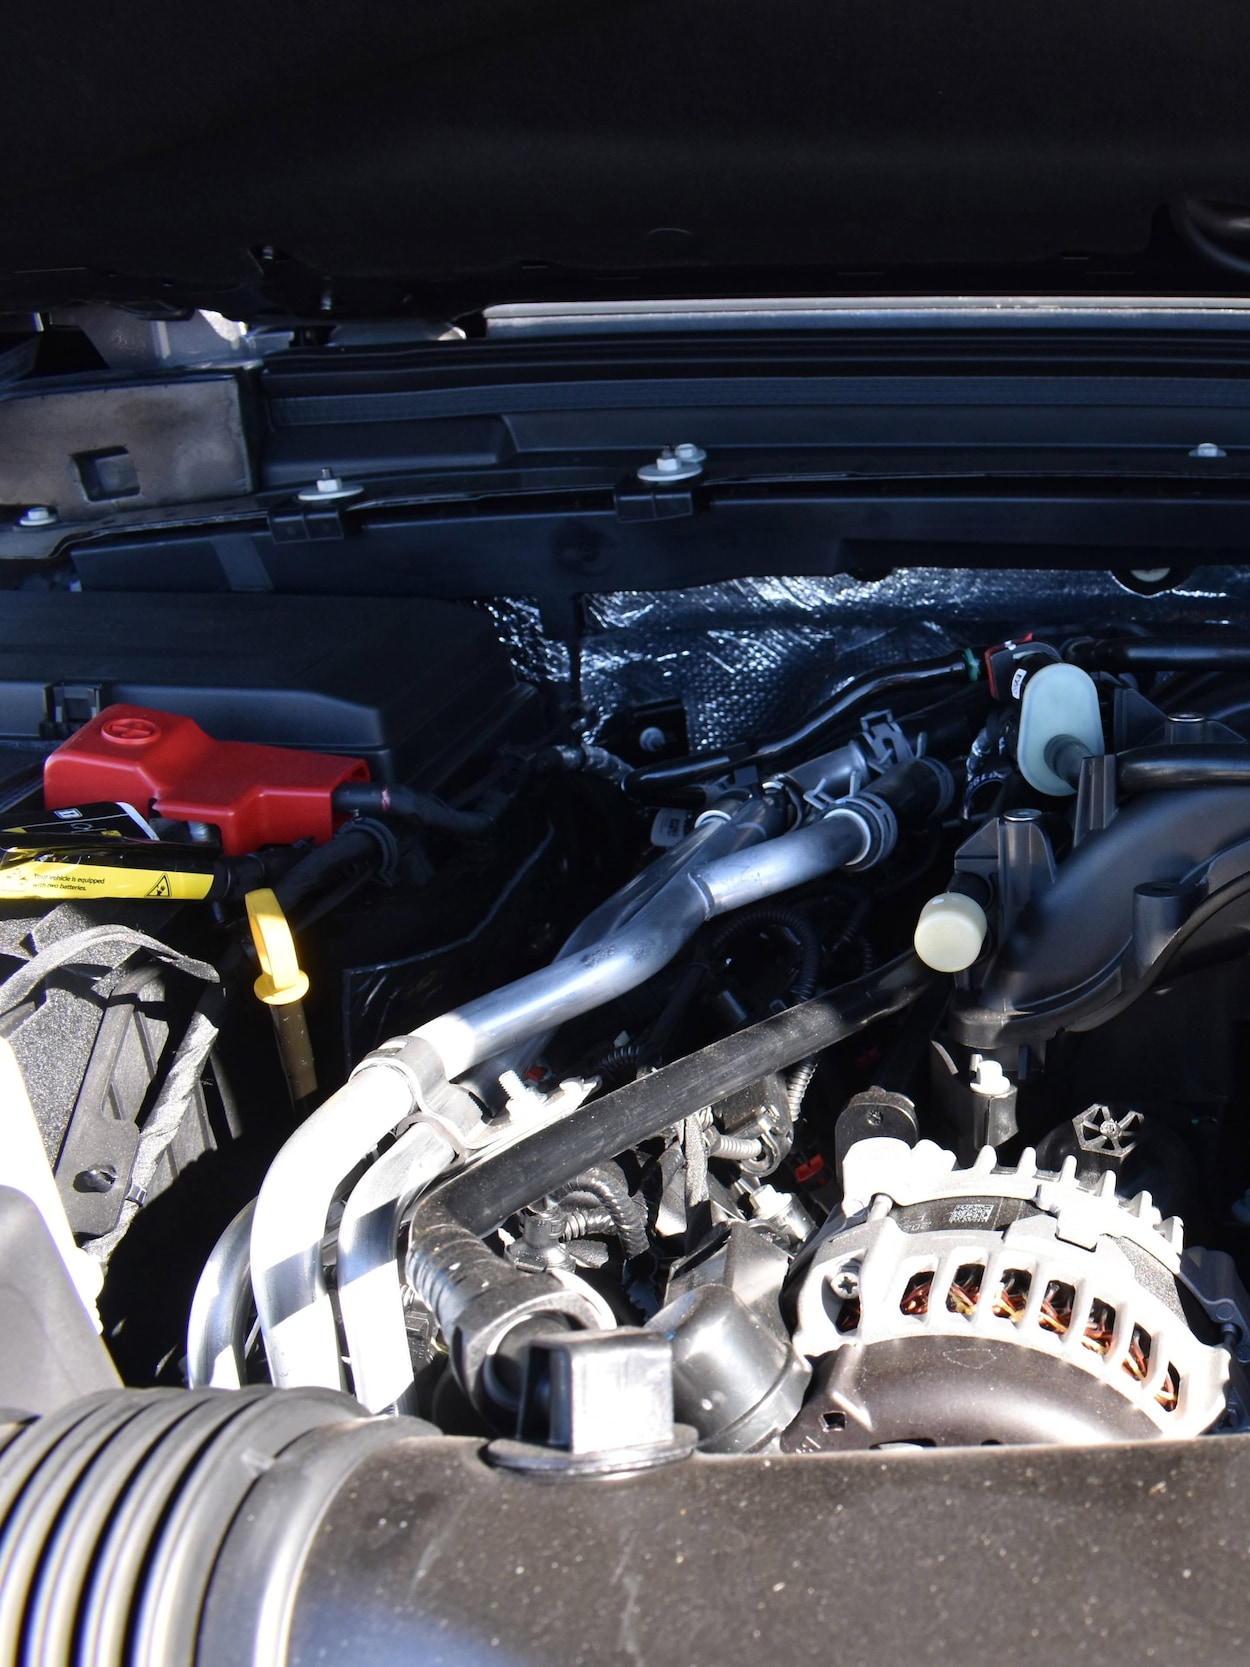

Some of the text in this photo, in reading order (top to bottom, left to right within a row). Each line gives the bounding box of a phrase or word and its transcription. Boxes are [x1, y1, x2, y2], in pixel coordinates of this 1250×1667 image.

[49, 874, 71, 882] vehicle
[77, 876, 105, 884] equipped
[59, 883, 87, 891] batteries.
